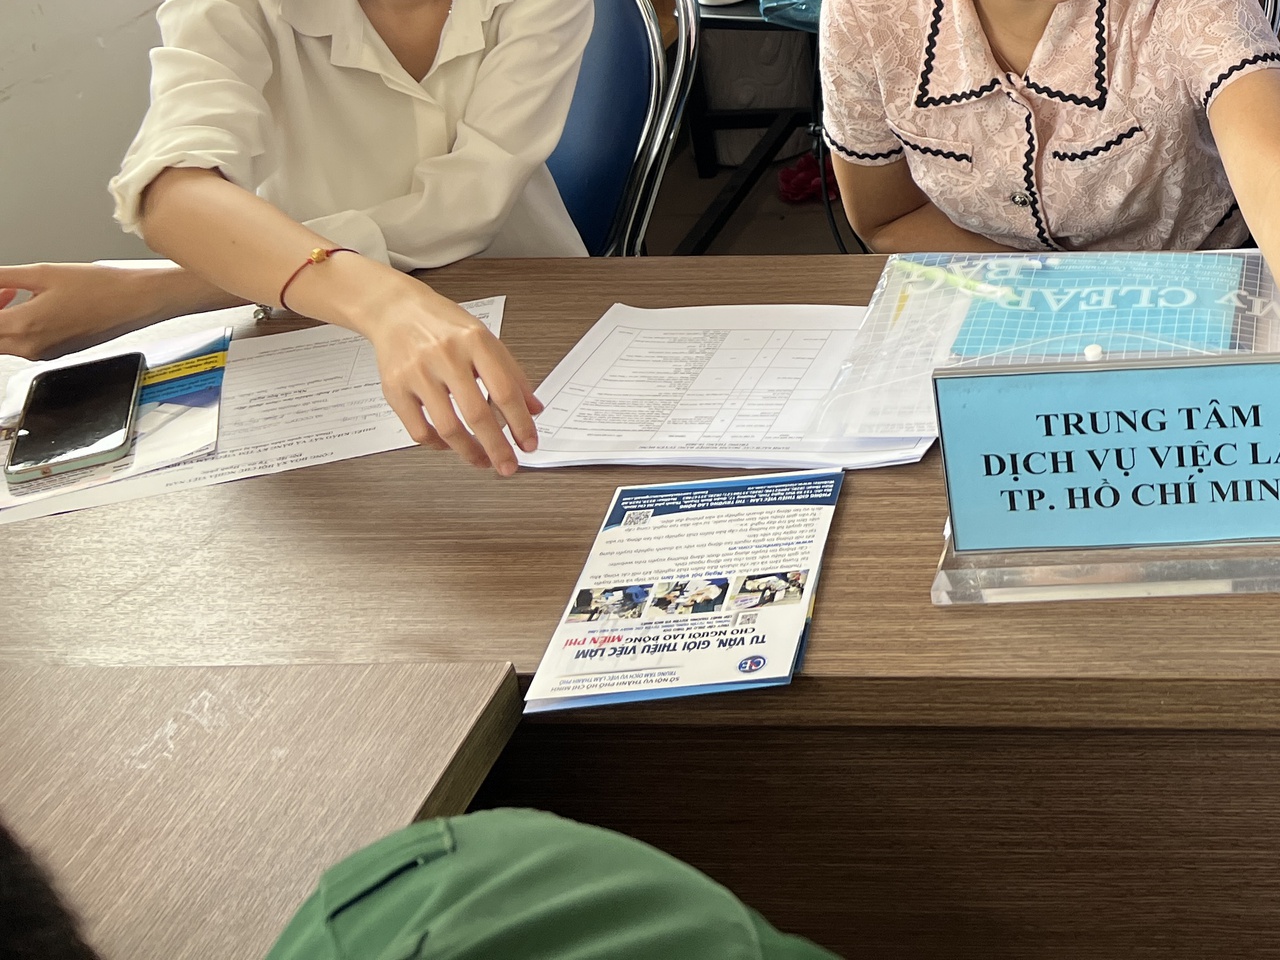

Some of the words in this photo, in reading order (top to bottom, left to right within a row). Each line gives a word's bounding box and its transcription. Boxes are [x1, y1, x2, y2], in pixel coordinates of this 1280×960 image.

[999, 284, 1198, 313] CLEAR
[1035, 407, 1169, 438] TRUNG
[1178, 398, 1263, 431] TÂM
[980, 450, 1077, 482] DỊCH
[1085, 446, 1138, 477] VỤ
[1147, 439, 1238, 474] VIỆC
[1000, 489, 1056, 512] TP.
[1065, 477, 1121, 511] HỒ
[1131, 474, 1200, 508] CHÍ
[661, 632, 685, 640] LAO
[687, 629, 727, 639] NGƯỜI
[730, 626, 756, 635] CHO
[561, 637, 587, 649] PHÍ
[586, 634, 624, 648] MIỄN
[623, 634, 660, 644] ĐỘNG
[680, 639, 711, 653] GIỚI
[572, 647, 606, 661] LÀM
[605, 642, 639, 658] VIỆC
[639, 640, 679, 656] THIỆU
